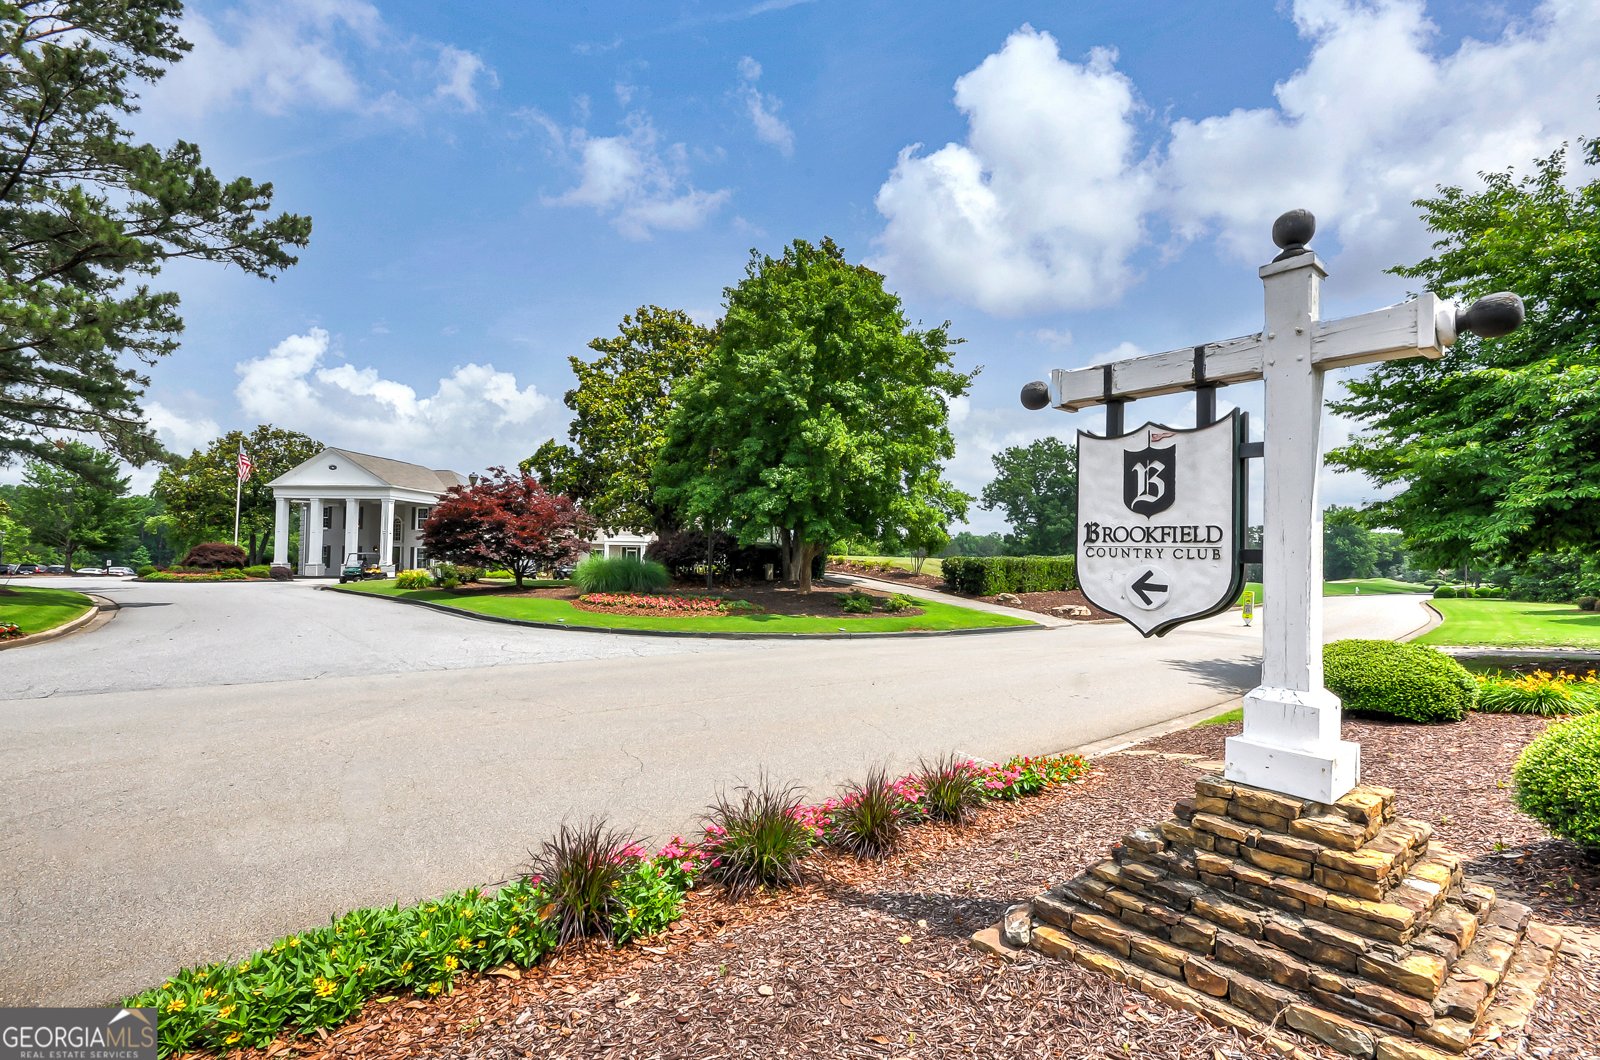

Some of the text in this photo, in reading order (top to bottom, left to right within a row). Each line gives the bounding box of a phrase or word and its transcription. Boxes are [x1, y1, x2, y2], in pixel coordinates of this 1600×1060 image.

[1131, 459, 1166, 510] B
[1083, 521, 1223, 546] BROOKFIELD
[1085, 546, 1221, 560] COUNTRY CLUB
